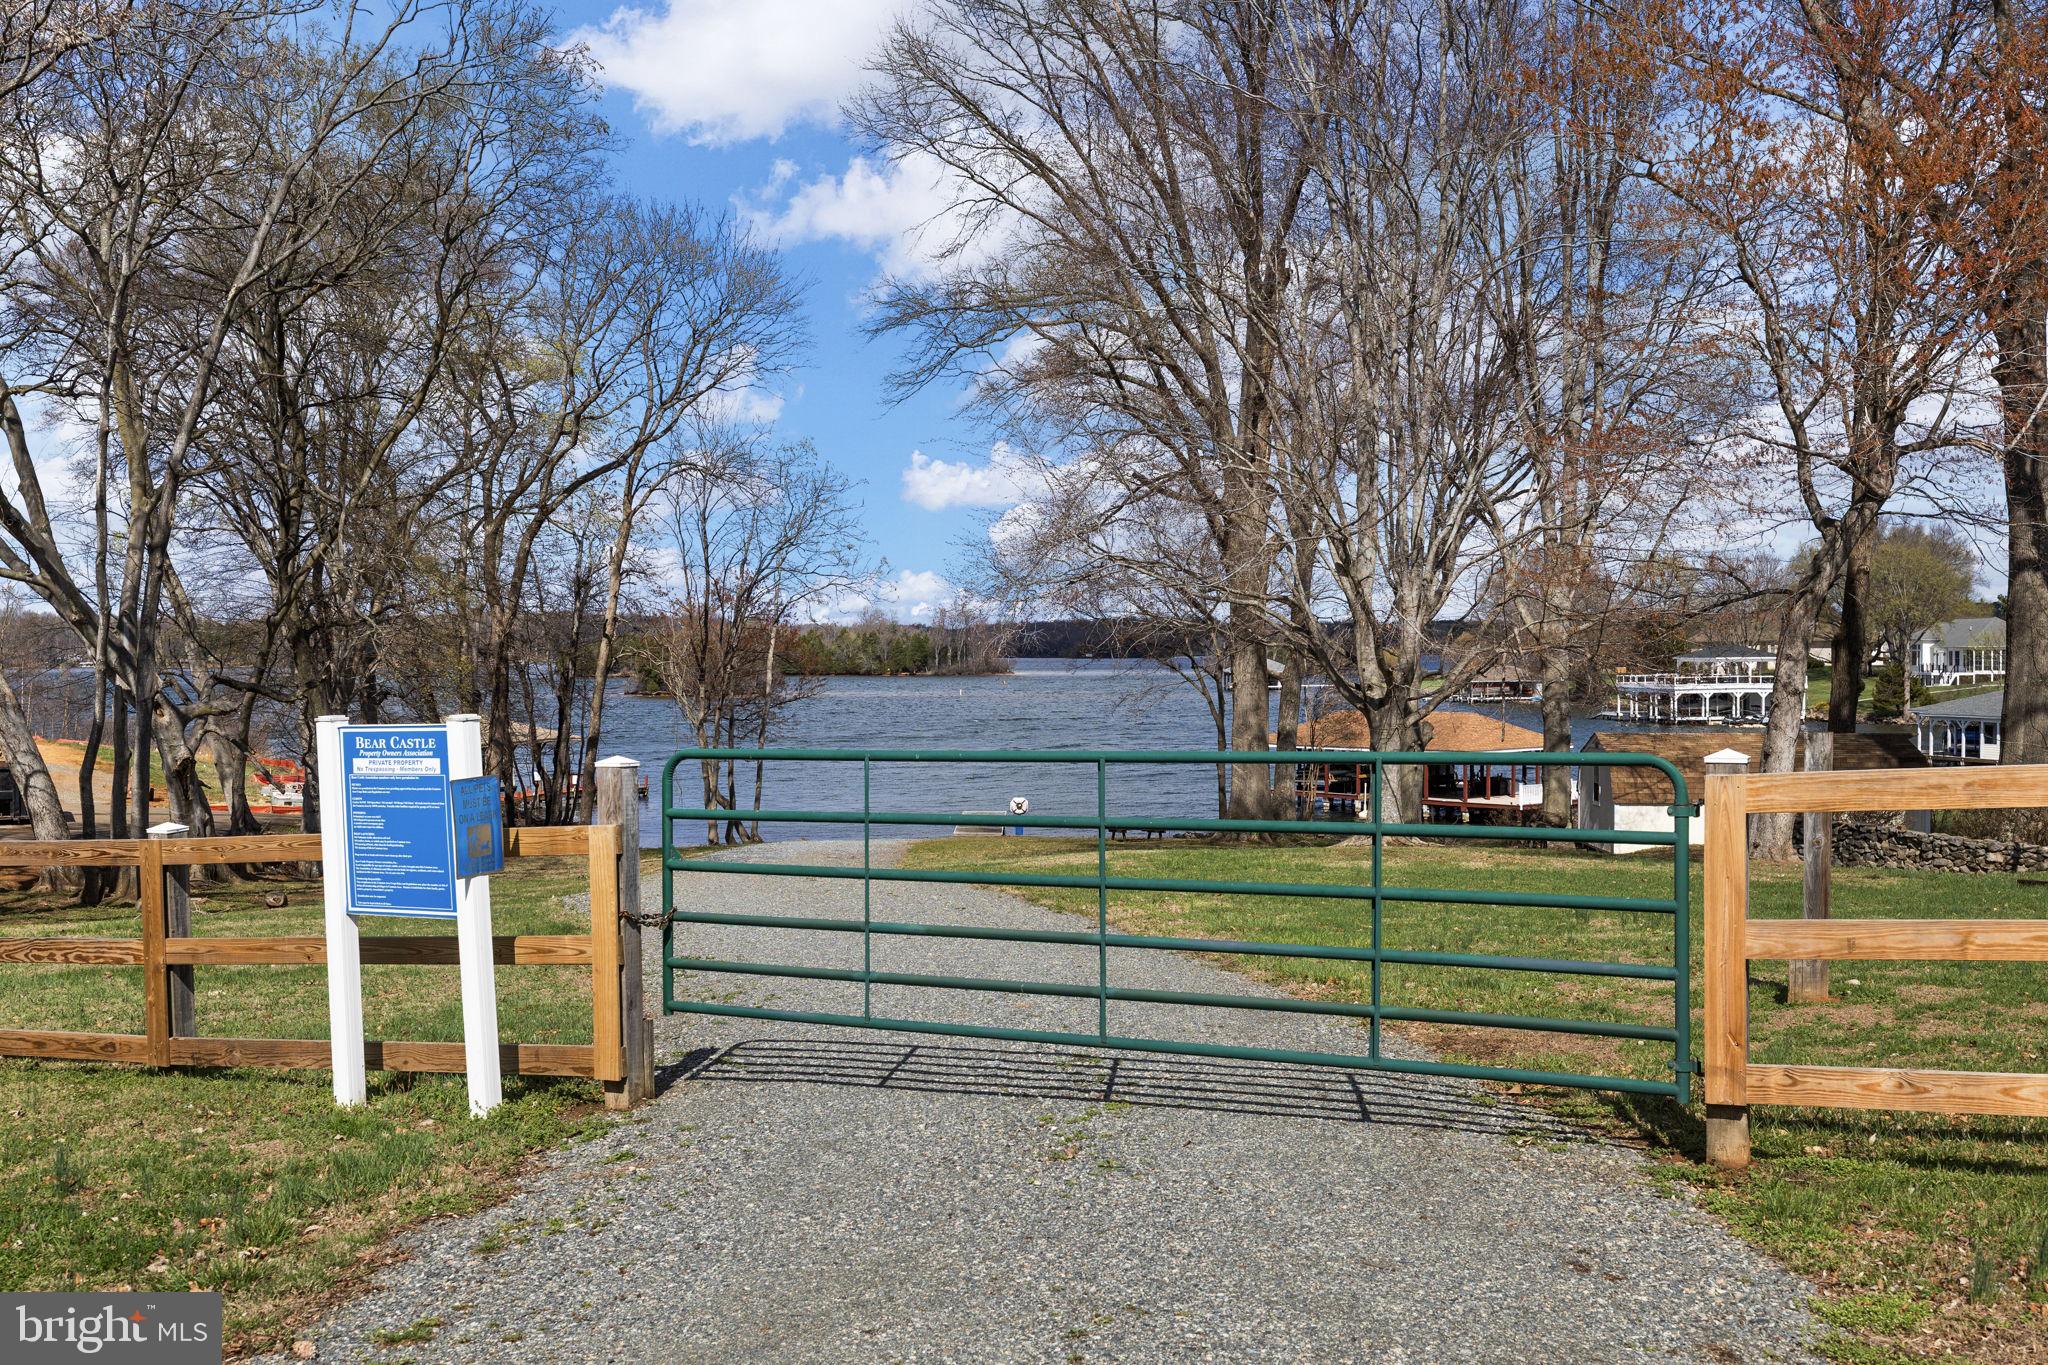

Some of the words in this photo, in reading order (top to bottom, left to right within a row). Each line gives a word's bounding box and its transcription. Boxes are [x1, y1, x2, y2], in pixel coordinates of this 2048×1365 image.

[355, 736, 386, 749] BEAR
[390, 736, 436, 749] CASTLE
[359, 749, 381, 758] Property
[473, 783, 492, 794] PETS
[462, 797, 480, 809] MUST
[482, 795, 491, 807] BE
